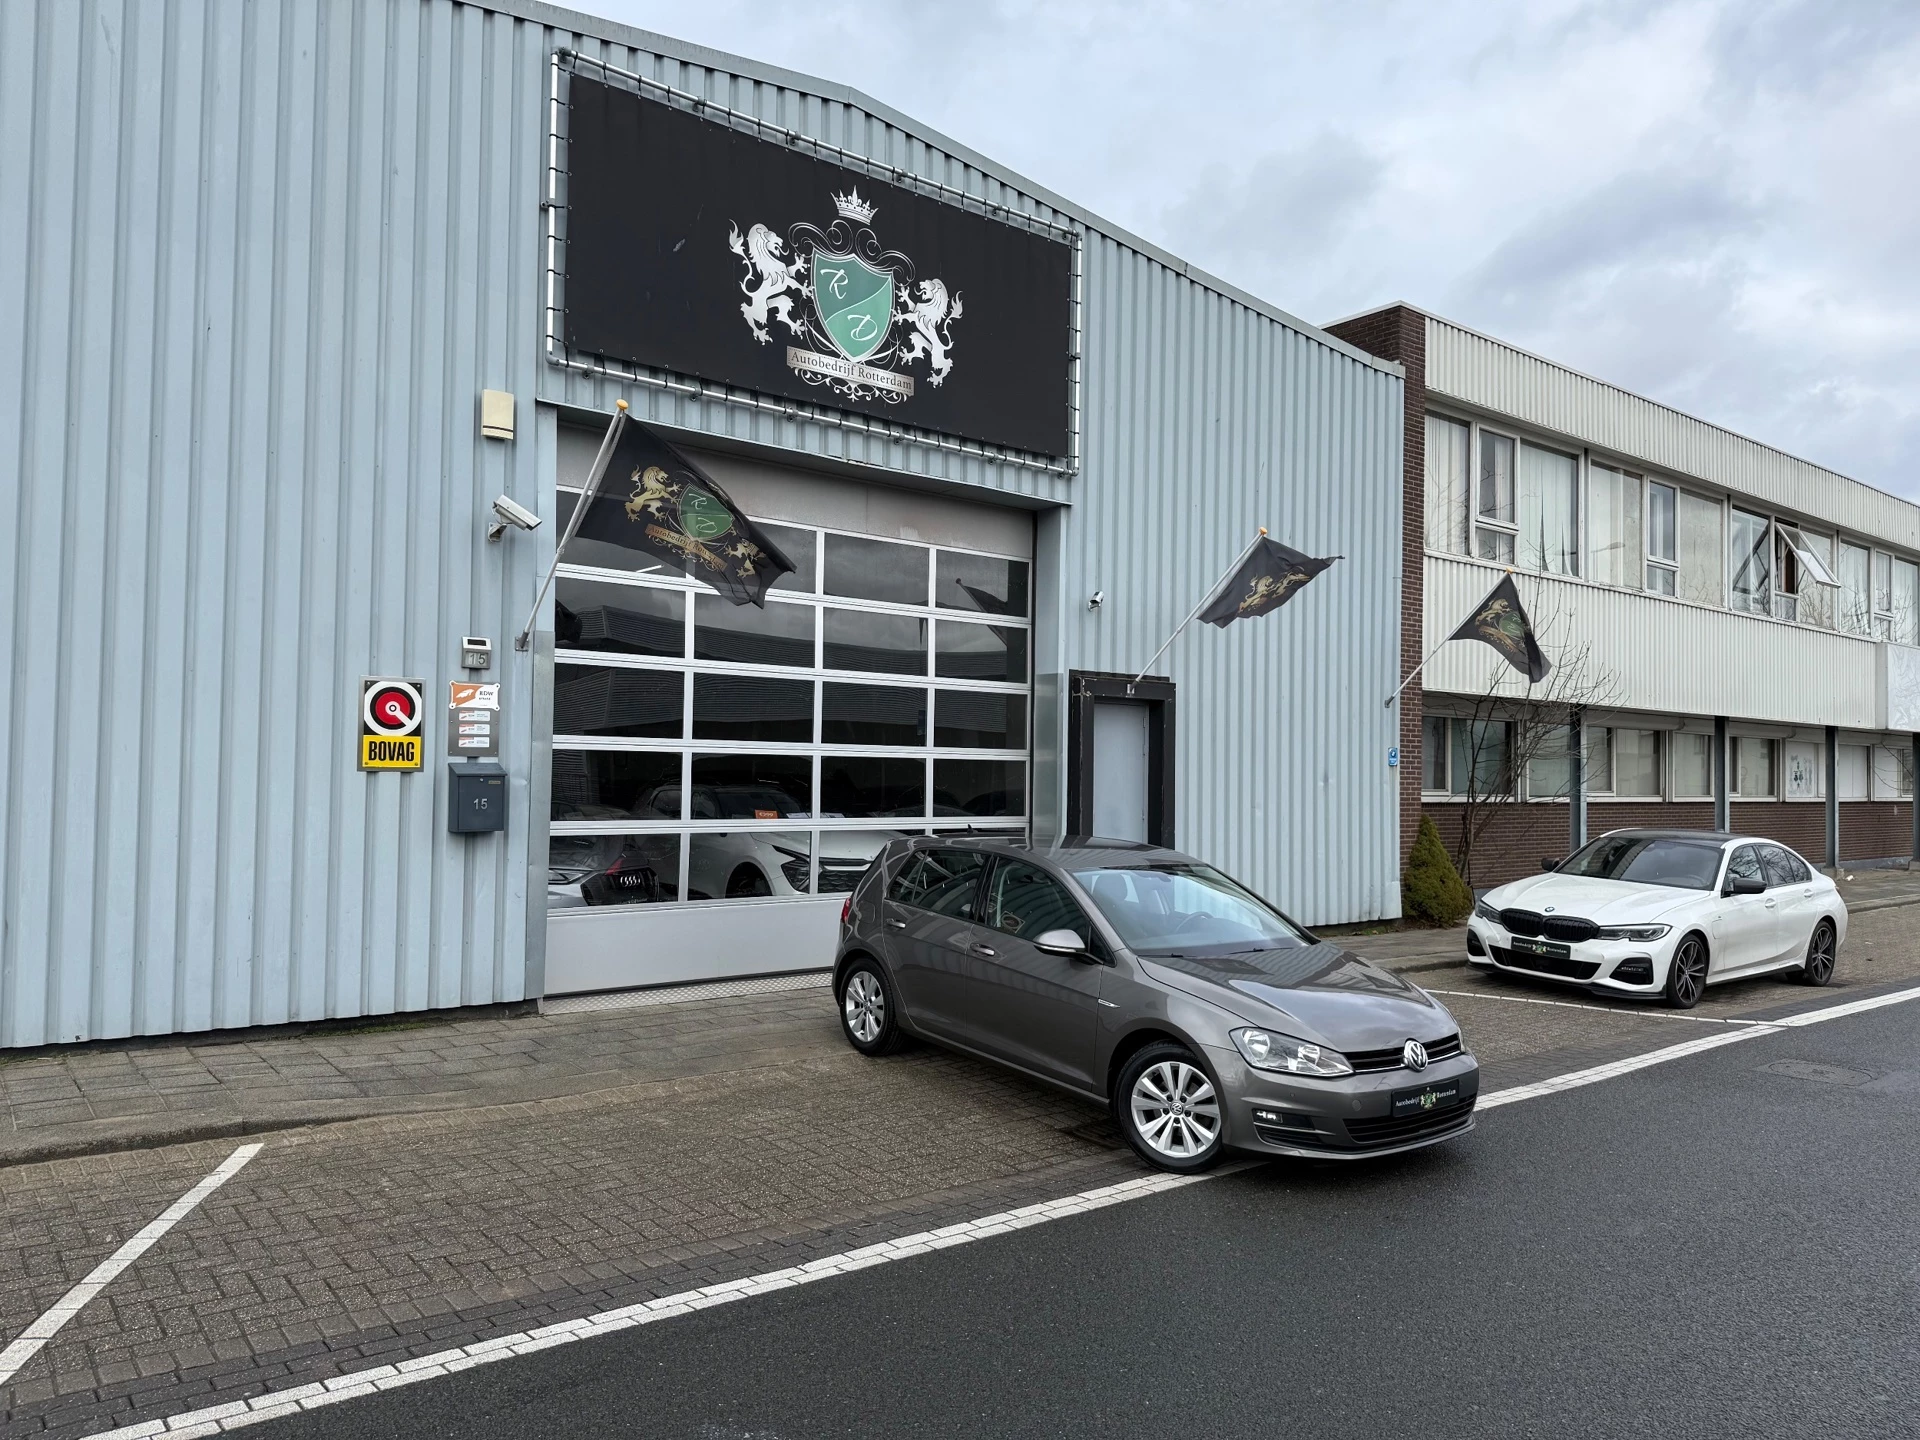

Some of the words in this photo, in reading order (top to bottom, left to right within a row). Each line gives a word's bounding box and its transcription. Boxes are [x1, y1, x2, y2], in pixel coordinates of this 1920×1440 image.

[791, 351, 856, 377] Autobedrijf
[857, 367, 912, 391] Rotterdam
[470, 653, 486, 665] 15
[368, 740, 415, 762] BOVAG
[473, 798, 488, 810] 15
